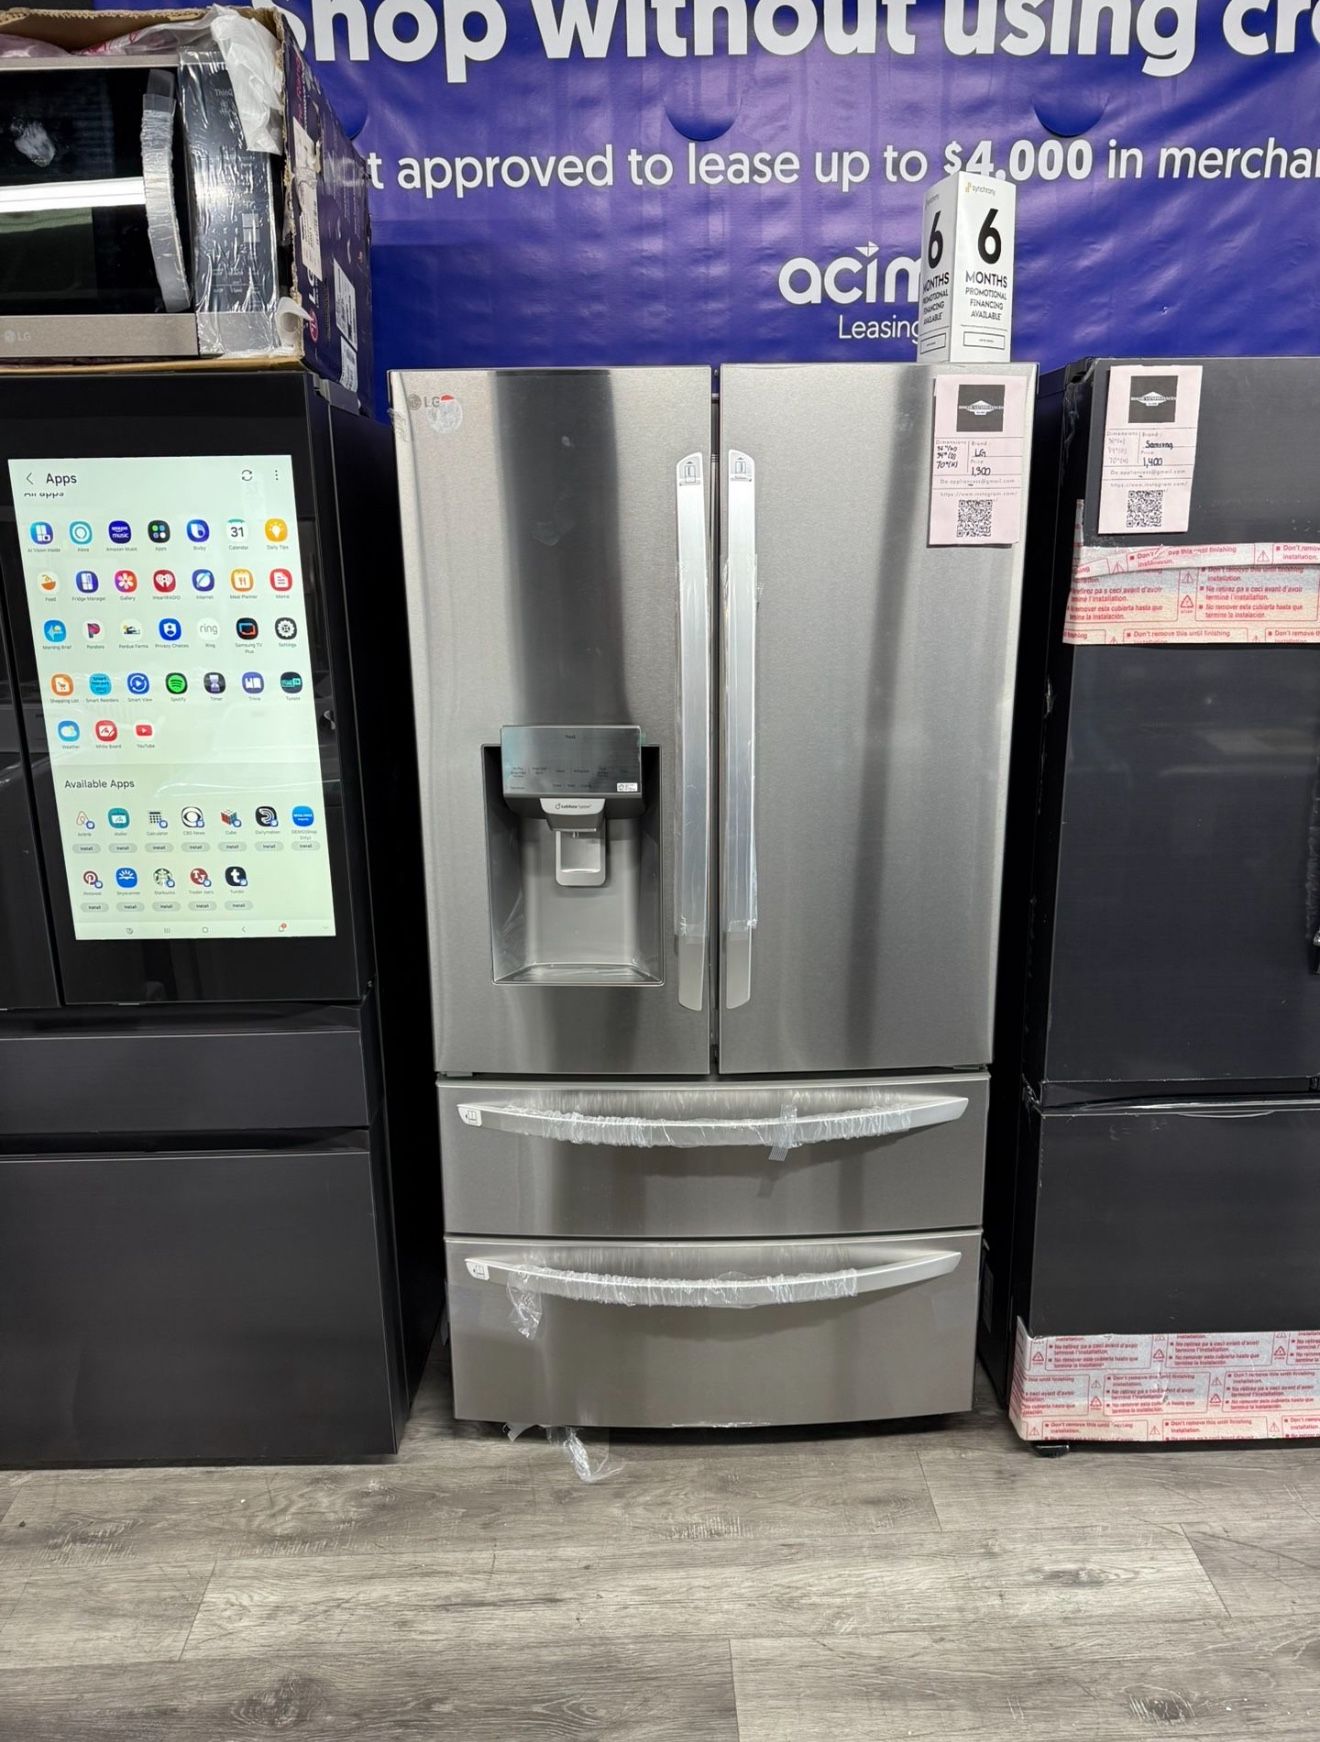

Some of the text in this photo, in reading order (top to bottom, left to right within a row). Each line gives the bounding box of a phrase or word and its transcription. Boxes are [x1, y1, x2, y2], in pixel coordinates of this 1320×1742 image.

[530, 0, 916, 59] without
[944, 0, 1197, 77] using
[1223, 0, 1320, 55] cr
[397, 143, 614, 200] approved
[627, 148, 674, 188] to
[688, 142, 800, 185] lease
[815, 150, 870, 193] up
[884, 144, 928, 183] to
[1108, 138, 1144, 179] in
[1158, 136, 1320, 179] mercha
[928, 210, 944, 270] 6
[978, 208, 1002, 265] 6
[965, 270, 1008, 289] MONTHS
[965, 287, 1007, 301] PROMOTIONAL
[970, 299, 1004, 311] FINANCING
[423, 396, 441, 408] LG
[974, 448, 987, 457] LG
[1143, 457, 1163, 468] 1,400
[46, 473, 77, 486] Apps
[231, 526, 244, 538] 31
[200, 625, 218, 635] ring
[64, 779, 135, 790] Available Apps
